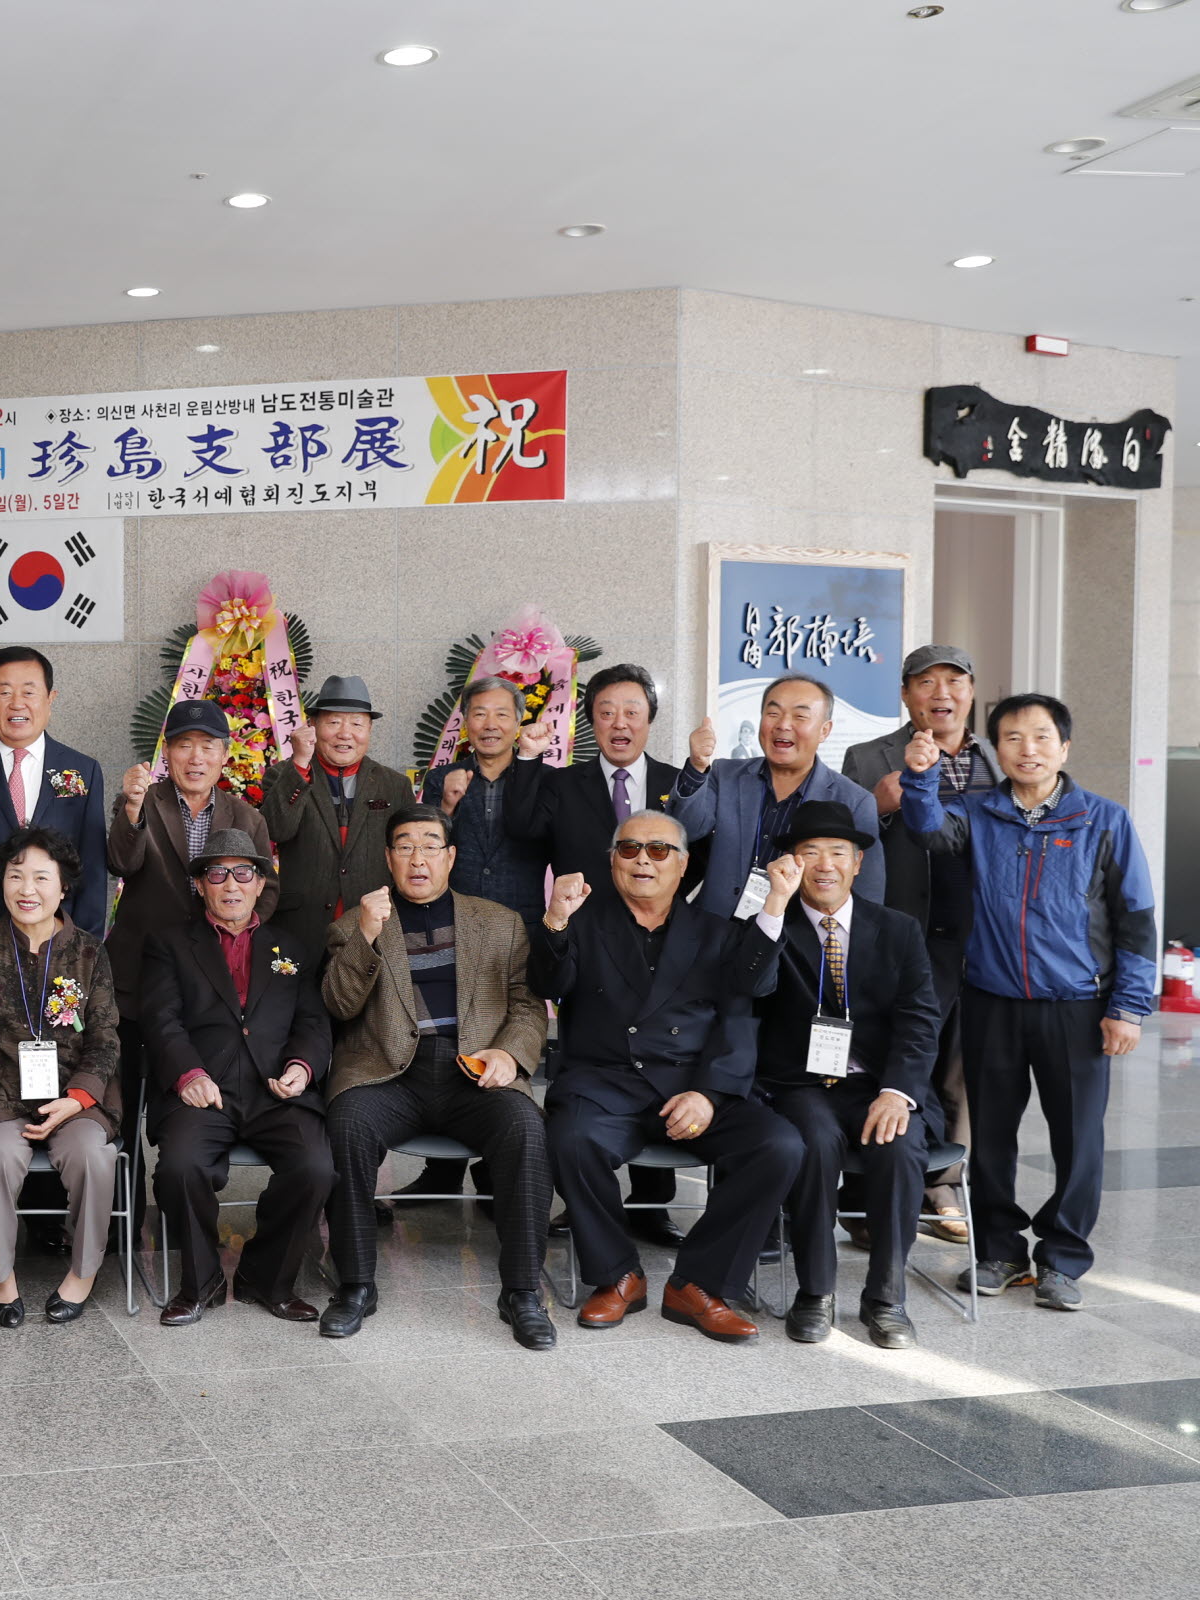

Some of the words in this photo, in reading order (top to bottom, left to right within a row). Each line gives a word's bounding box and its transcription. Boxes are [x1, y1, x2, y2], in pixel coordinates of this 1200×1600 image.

[59, 408, 91, 424] 장소:
[97, 405, 136, 421] 의신면
[141, 402, 181, 418] 사천리
[186, 398, 255, 416] 운림산방내
[261, 388, 395, 413] 남도전통미술관
[459, 394, 548, 475] 祝
[43, 492, 80, 510] 5일간
[269, 659, 292, 680] 祝
